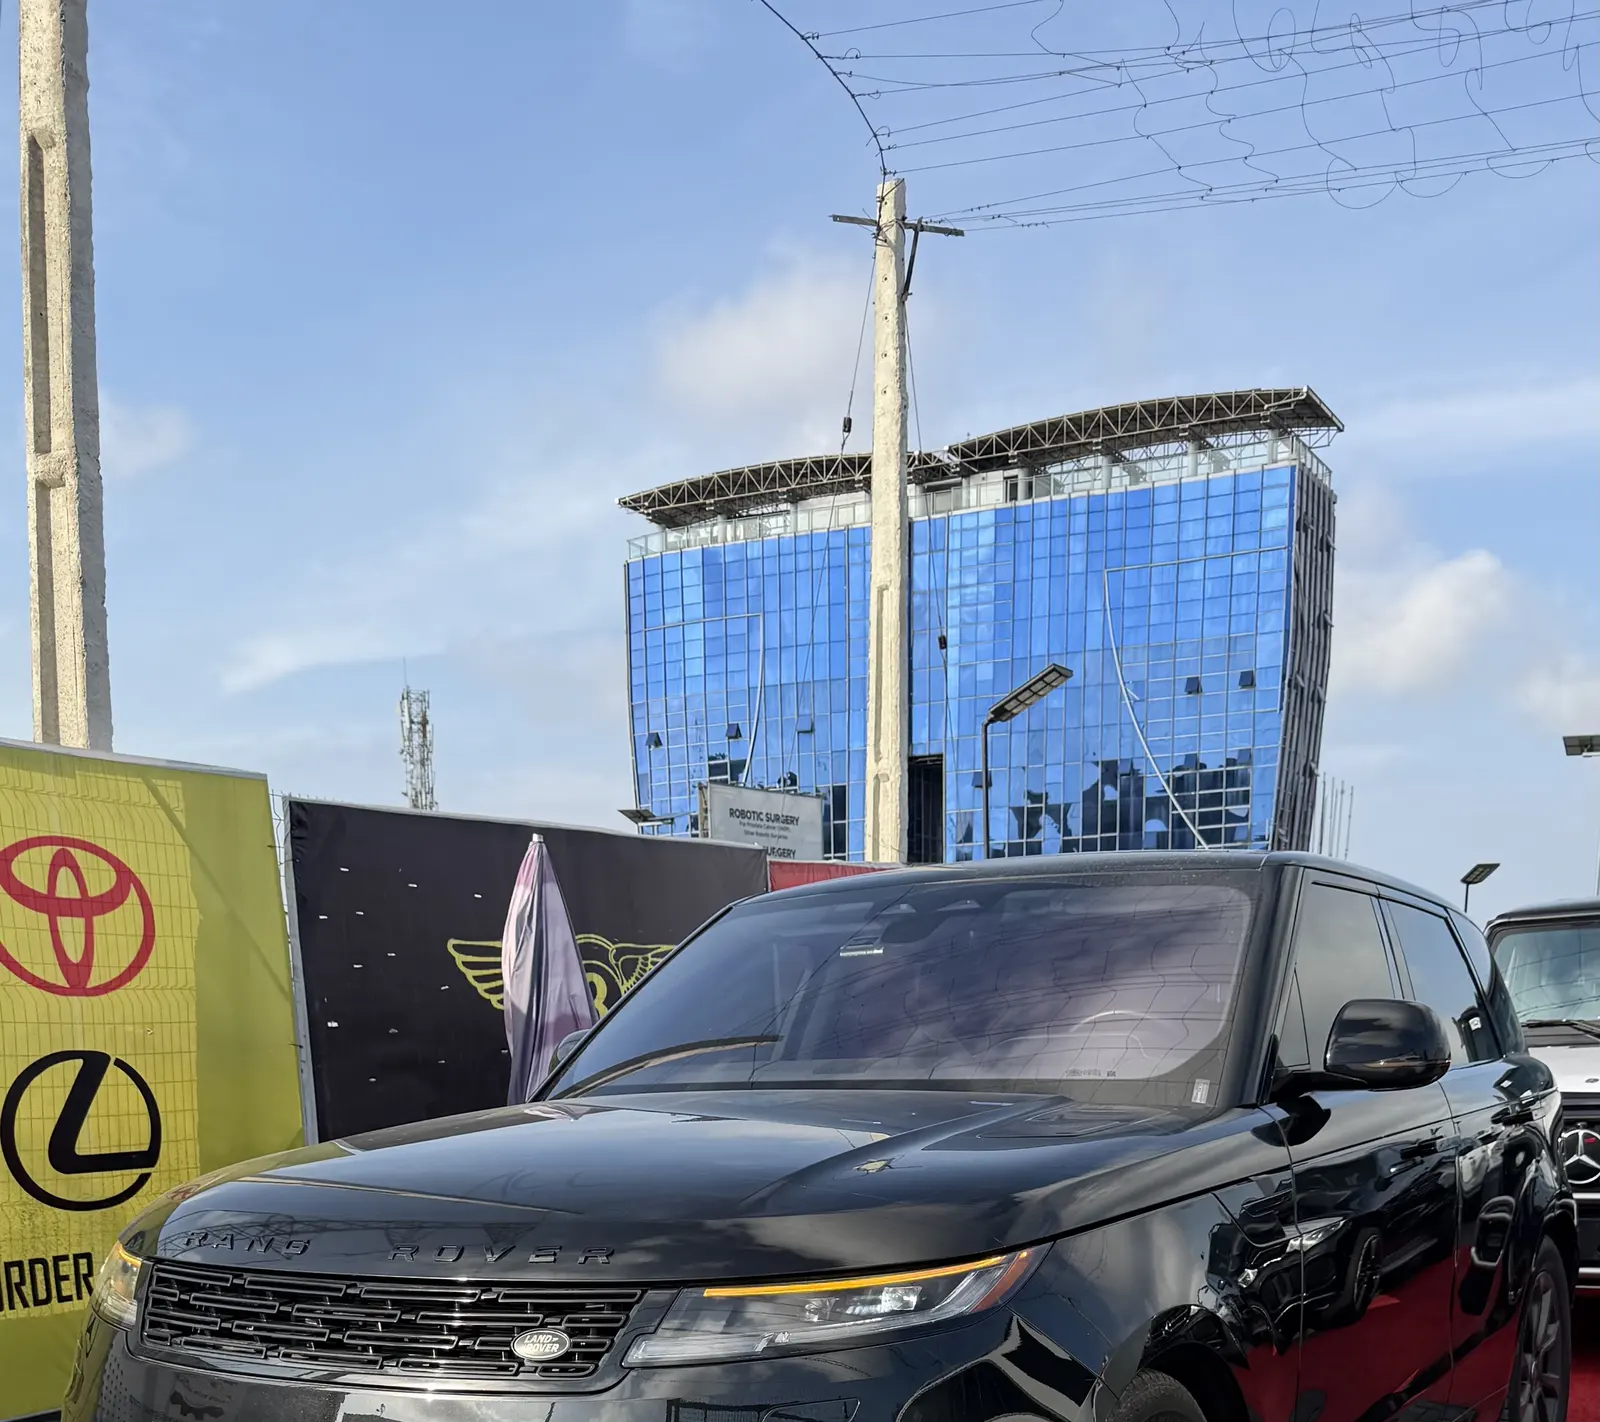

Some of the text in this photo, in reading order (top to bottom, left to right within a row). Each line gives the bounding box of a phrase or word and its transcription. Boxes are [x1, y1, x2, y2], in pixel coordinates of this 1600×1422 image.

[729, 808, 800, 826] ROBOTIC SURGERY
[763, 846, 797, 859] URGERY
[387, 1245, 615, 1265] ROVER
[0, 1251, 94, 1312] RDER
[525, 1343, 560, 1353] ROVER
